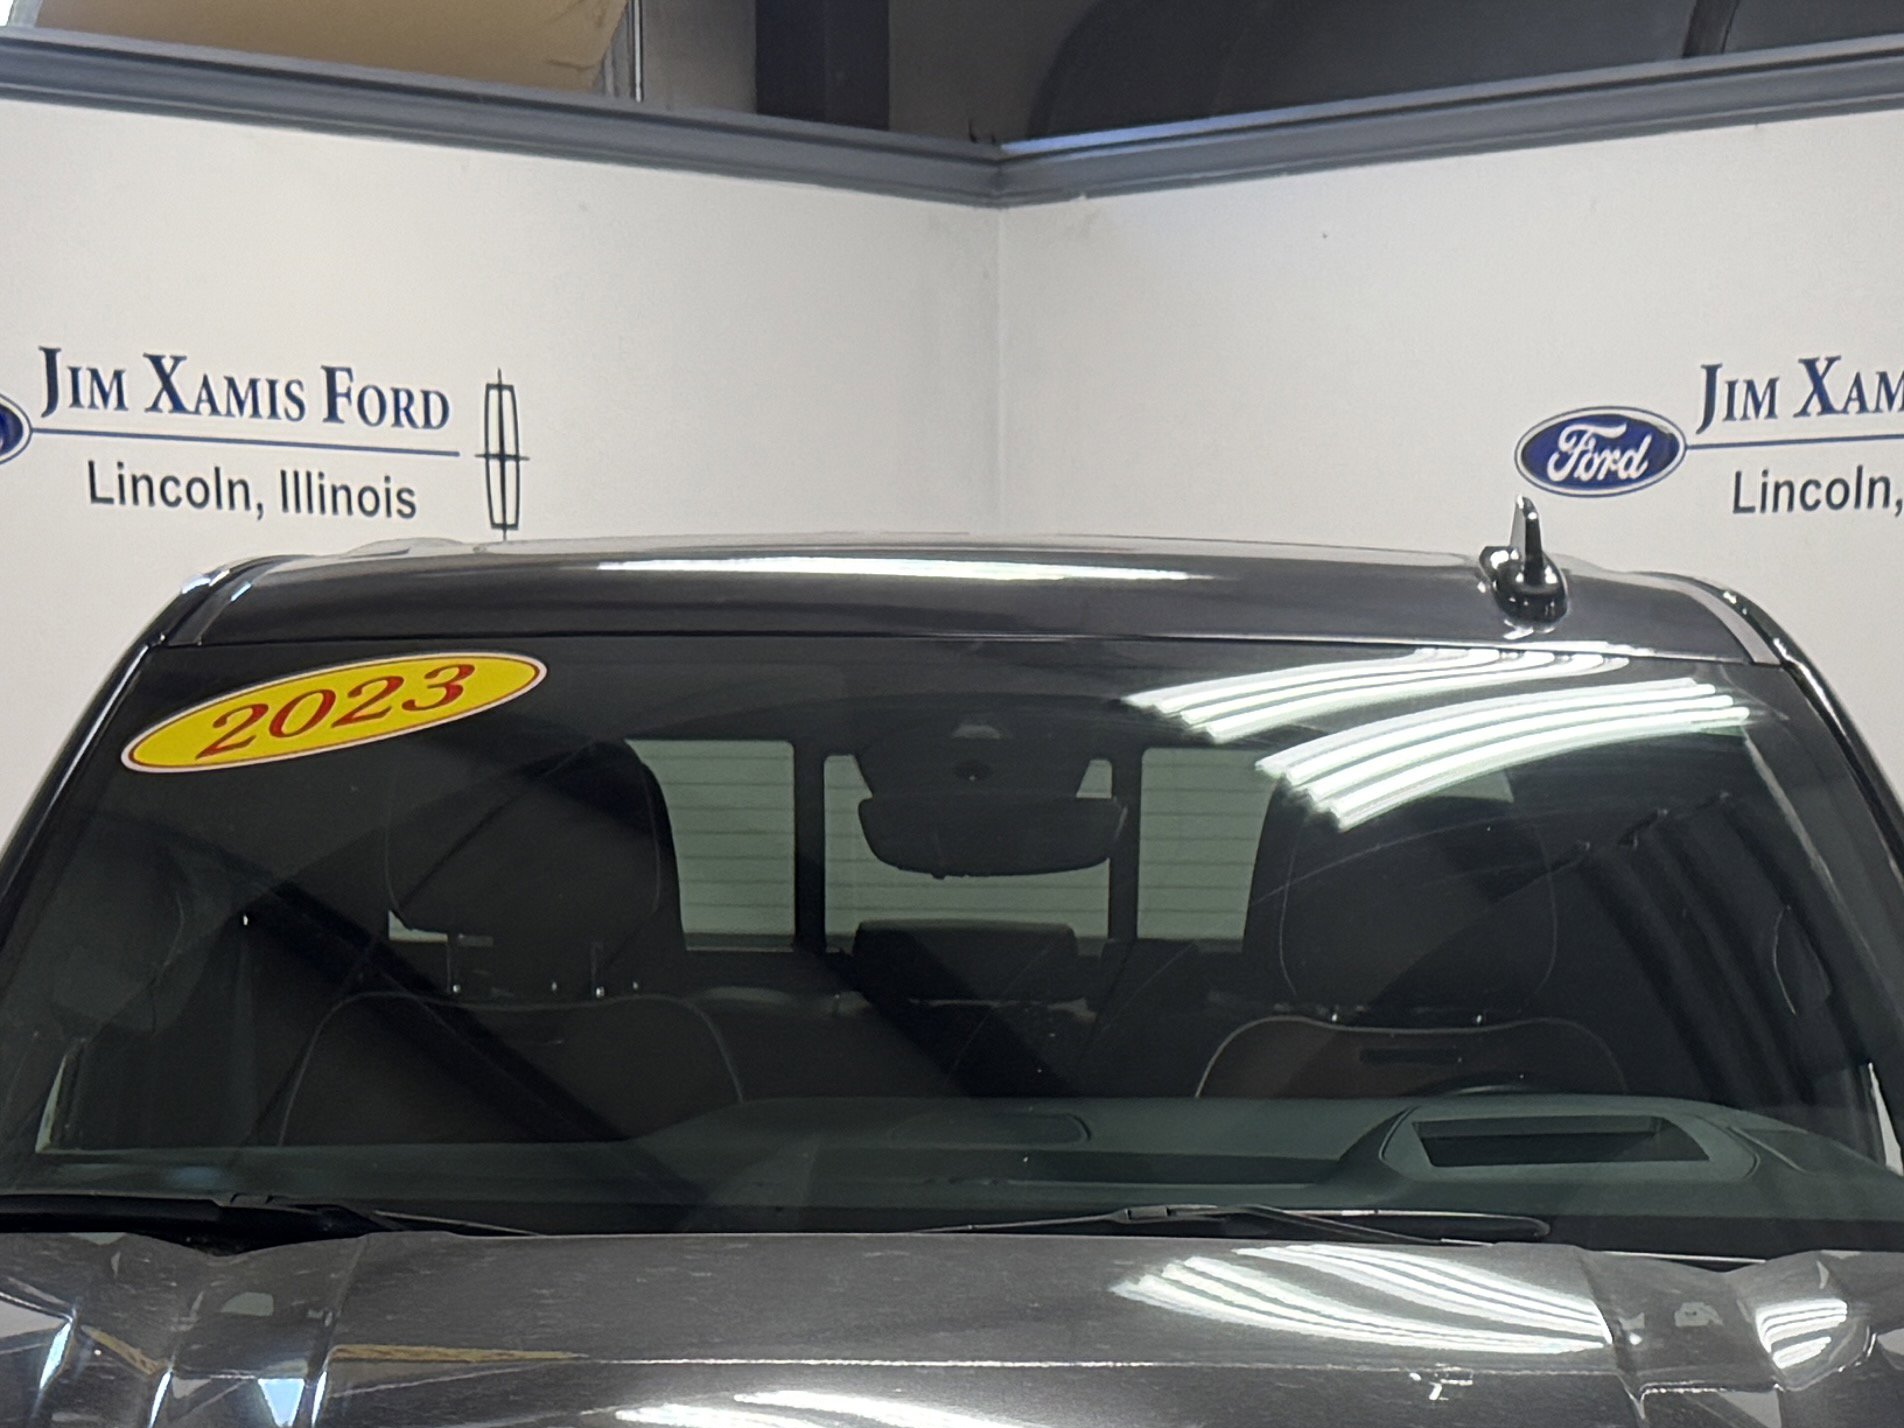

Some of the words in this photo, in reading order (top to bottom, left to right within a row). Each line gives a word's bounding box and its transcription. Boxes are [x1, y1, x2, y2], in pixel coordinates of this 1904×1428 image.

[38, 346, 128, 419] JIM
[142, 352, 306, 422] XAMIS
[320, 365, 450, 430] FORD
[1695, 363, 1780, 435] JIM
[1545, 421, 1650, 485] Ford
[87, 459, 264, 521] Lincoln,
[280, 469, 417, 519] Illinois
[1732, 464, 1903, 518] Lincoln,
[195, 662, 476, 761] 2023
